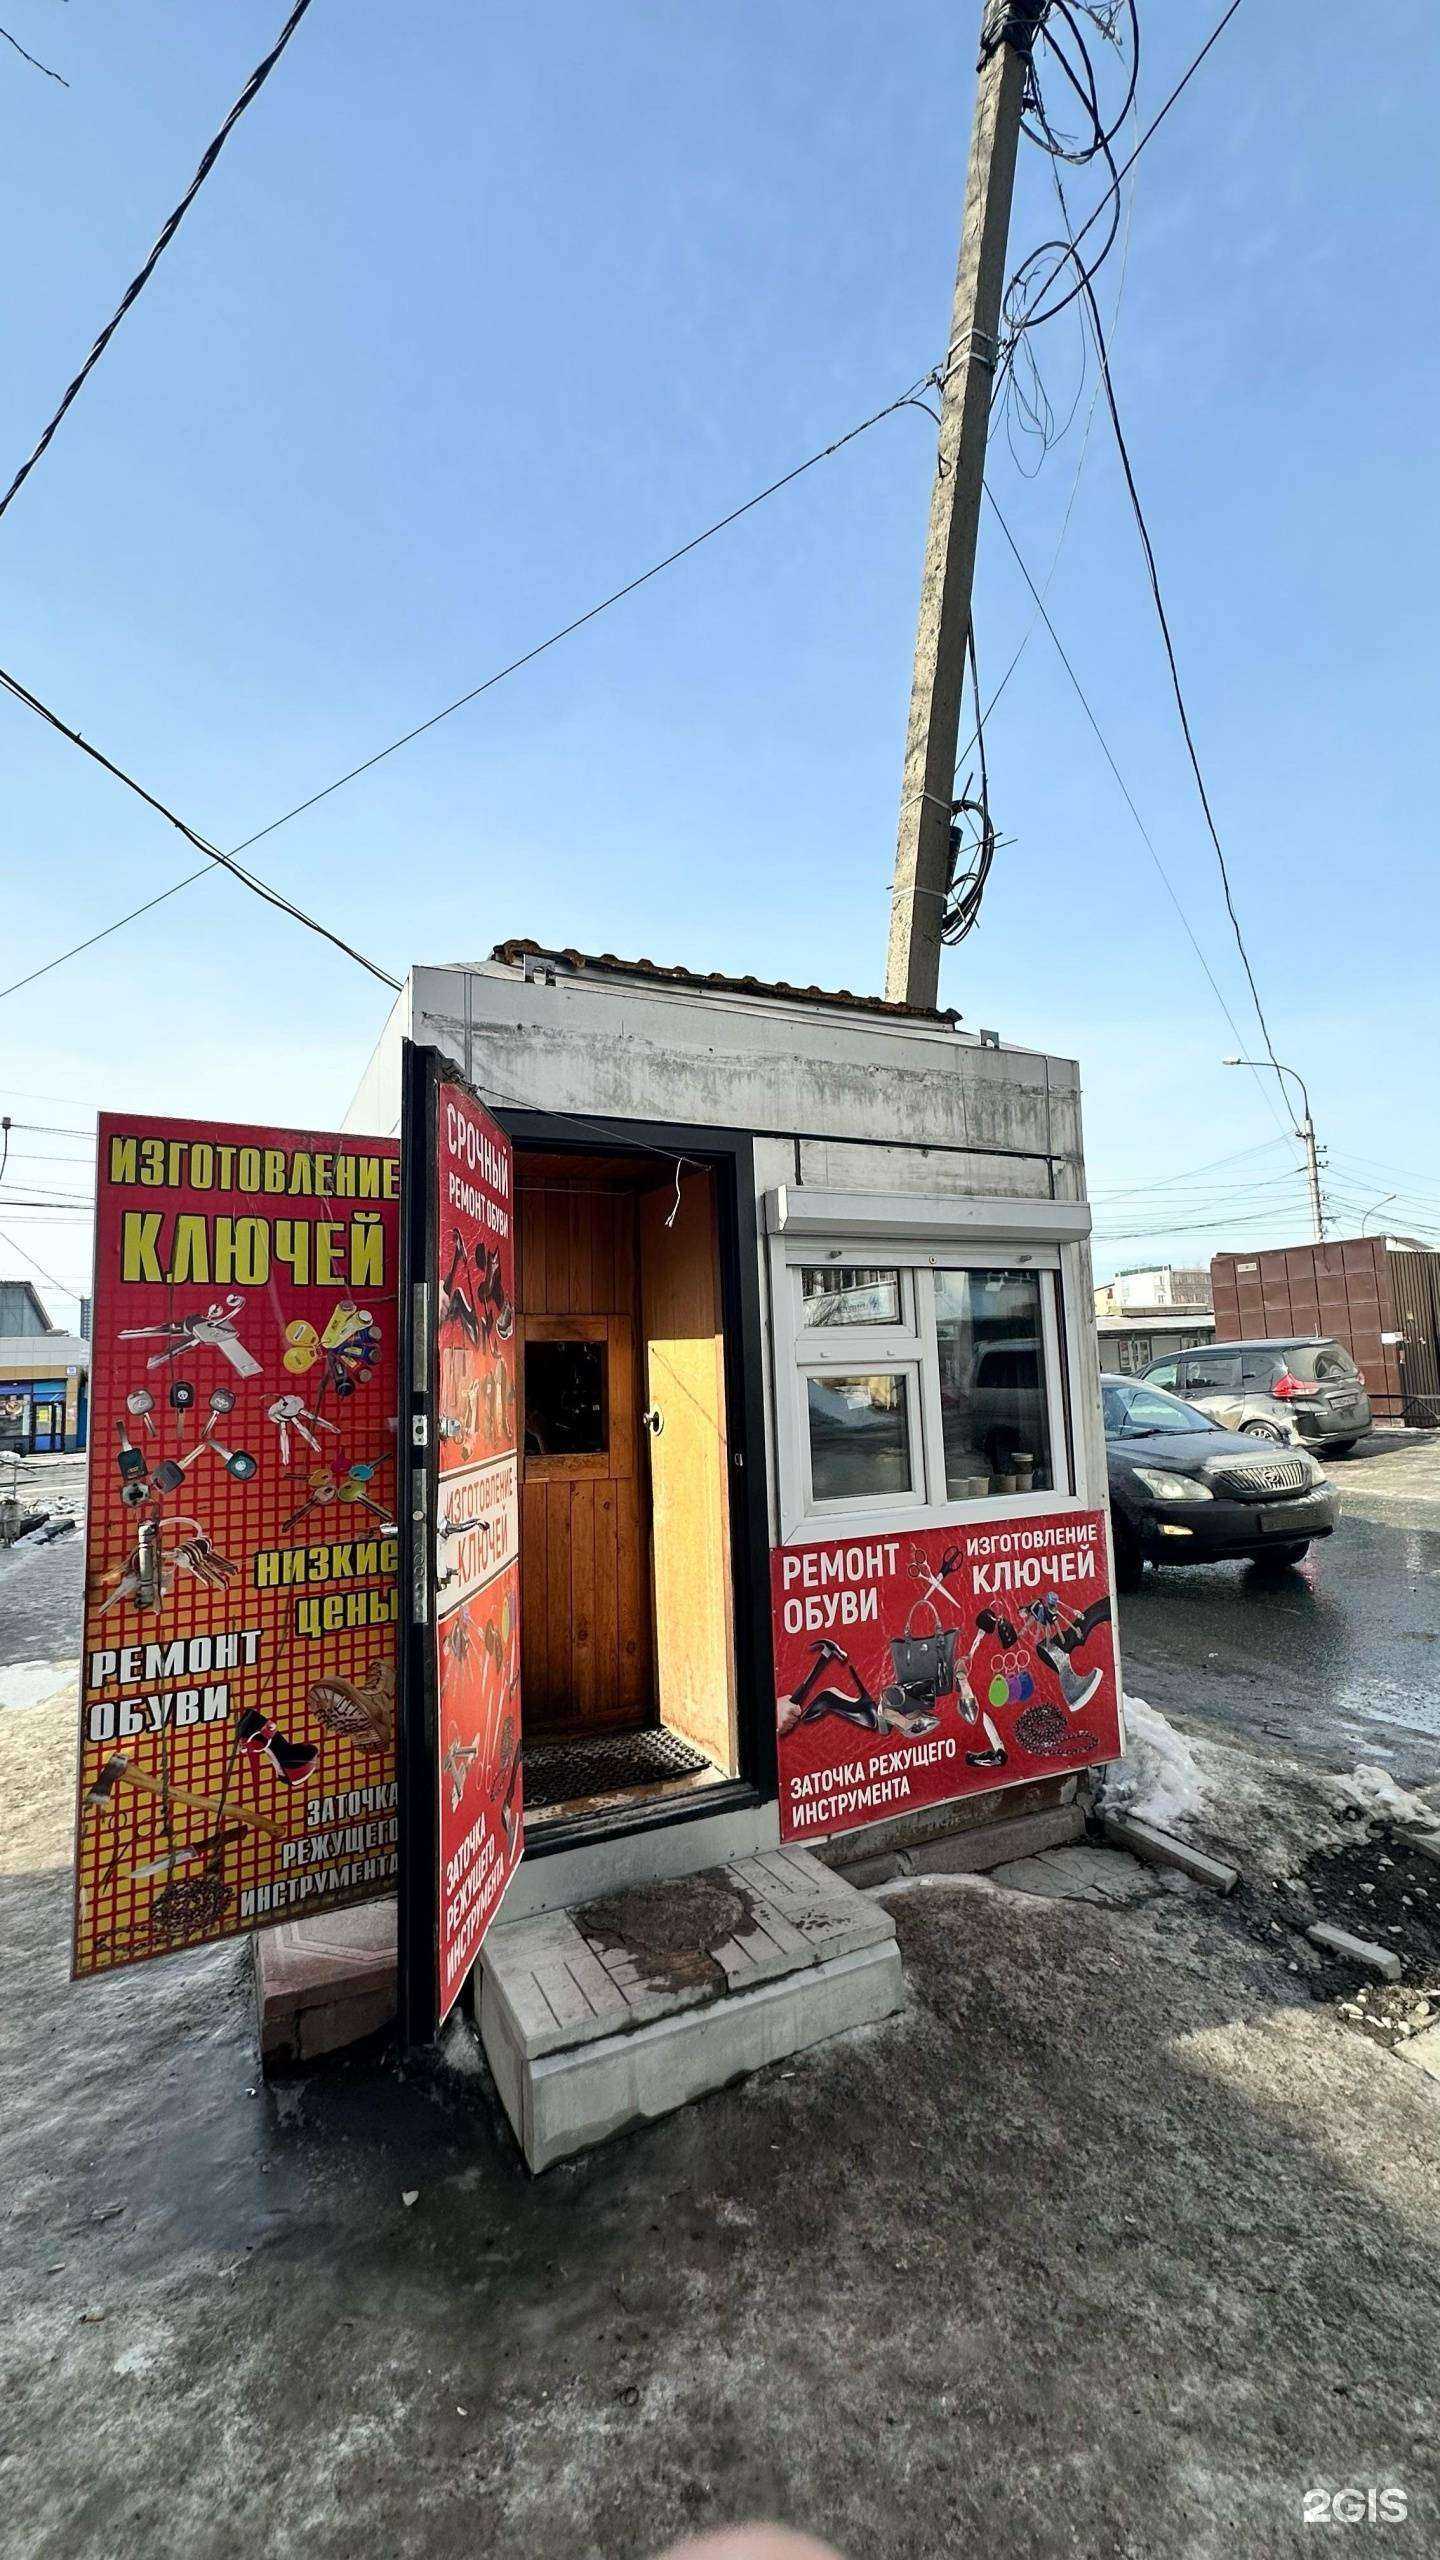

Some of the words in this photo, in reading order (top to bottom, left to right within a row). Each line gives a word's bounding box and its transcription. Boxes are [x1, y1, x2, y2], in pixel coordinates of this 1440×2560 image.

[110, 1137, 399, 1198] ИЗГОТОВЛЕНИЕ
[447, 1103, 508, 1199] СРОЧНЫЙ
[449, 1171, 485, 1222] РЕМОНТ
[487, 1200, 508, 1239] ОБУВИ
[123, 1212, 384, 1286] КЛЮЧЕЙ
[445, 1467, 513, 1524] ИЗГОТОВЛЕНИЕ
[458, 1503, 508, 1588] КЛЮЧЕЙ
[783, 1543, 900, 1590] РЕМОНТ
[967, 1524, 1098, 1557] ИЗГОТОВЛЕНИЕ
[973, 1546, 1096, 1595] КЛЮЧЕЙ
[784, 1587, 878, 1634] ОБУВИ
[91, 1630, 262, 1688] РЕМОНТ
[89, 1686, 228, 1741] ОБУВИ
[791, 1762, 864, 1799] ЗАТОЧКА
[870, 1738, 956, 1780] РЕЖУЩЕГО
[307, 1782, 398, 1826] ЗАТОЧКА
[792, 1776, 911, 1828] ИНСТРУМЕНТА
[283, 1817, 398, 1869] РЕЖУЩЕГО
[447, 1812, 486, 1896] ЗАТОЧКА
[240, 1852, 398, 1917] ИНСТРУМЕНТА
[447, 1833, 495, 1941] РЕЖУЩЕГО
[447, 1852, 504, 1986] ИНСТРУМЕНТА
